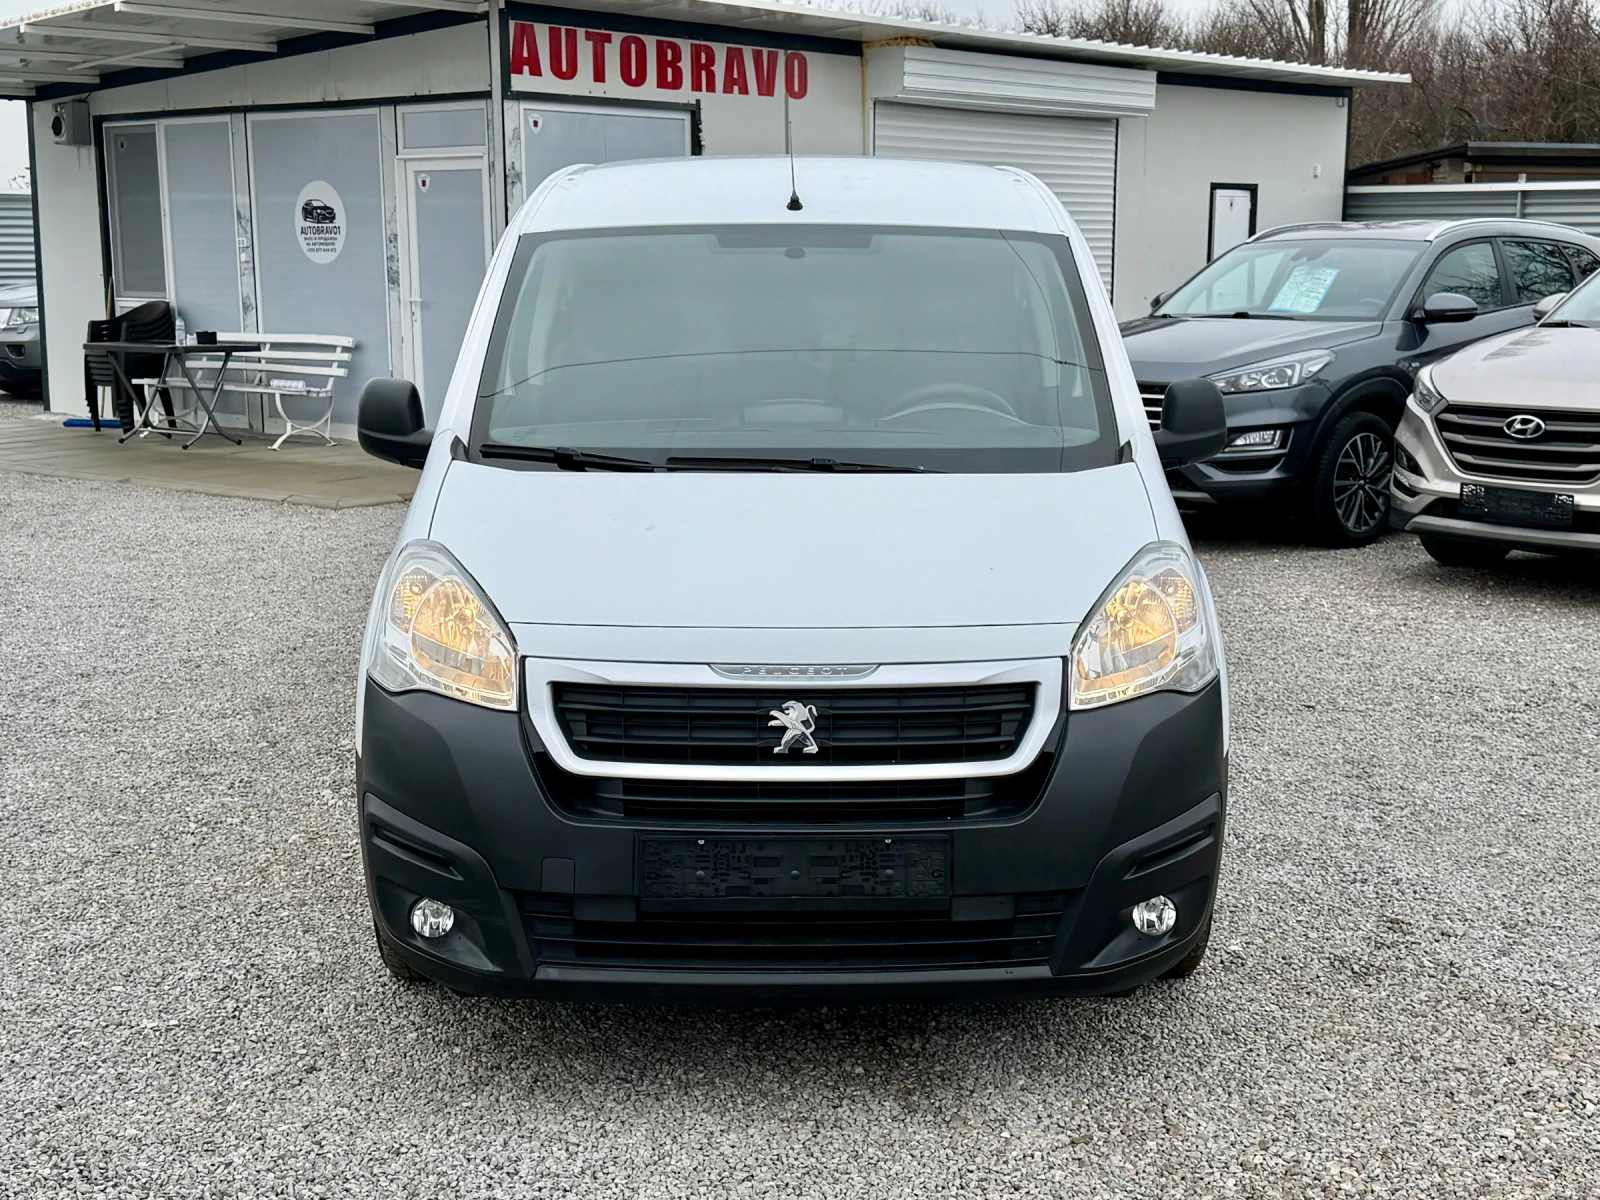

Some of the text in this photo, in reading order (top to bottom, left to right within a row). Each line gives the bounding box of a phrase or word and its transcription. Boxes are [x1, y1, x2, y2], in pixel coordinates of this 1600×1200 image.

[510, 22, 808, 100] AUTOBRAVO
[301, 226, 340, 235] AUTOBRAVO1
[742, 666, 848, 675] PEUGEOT
